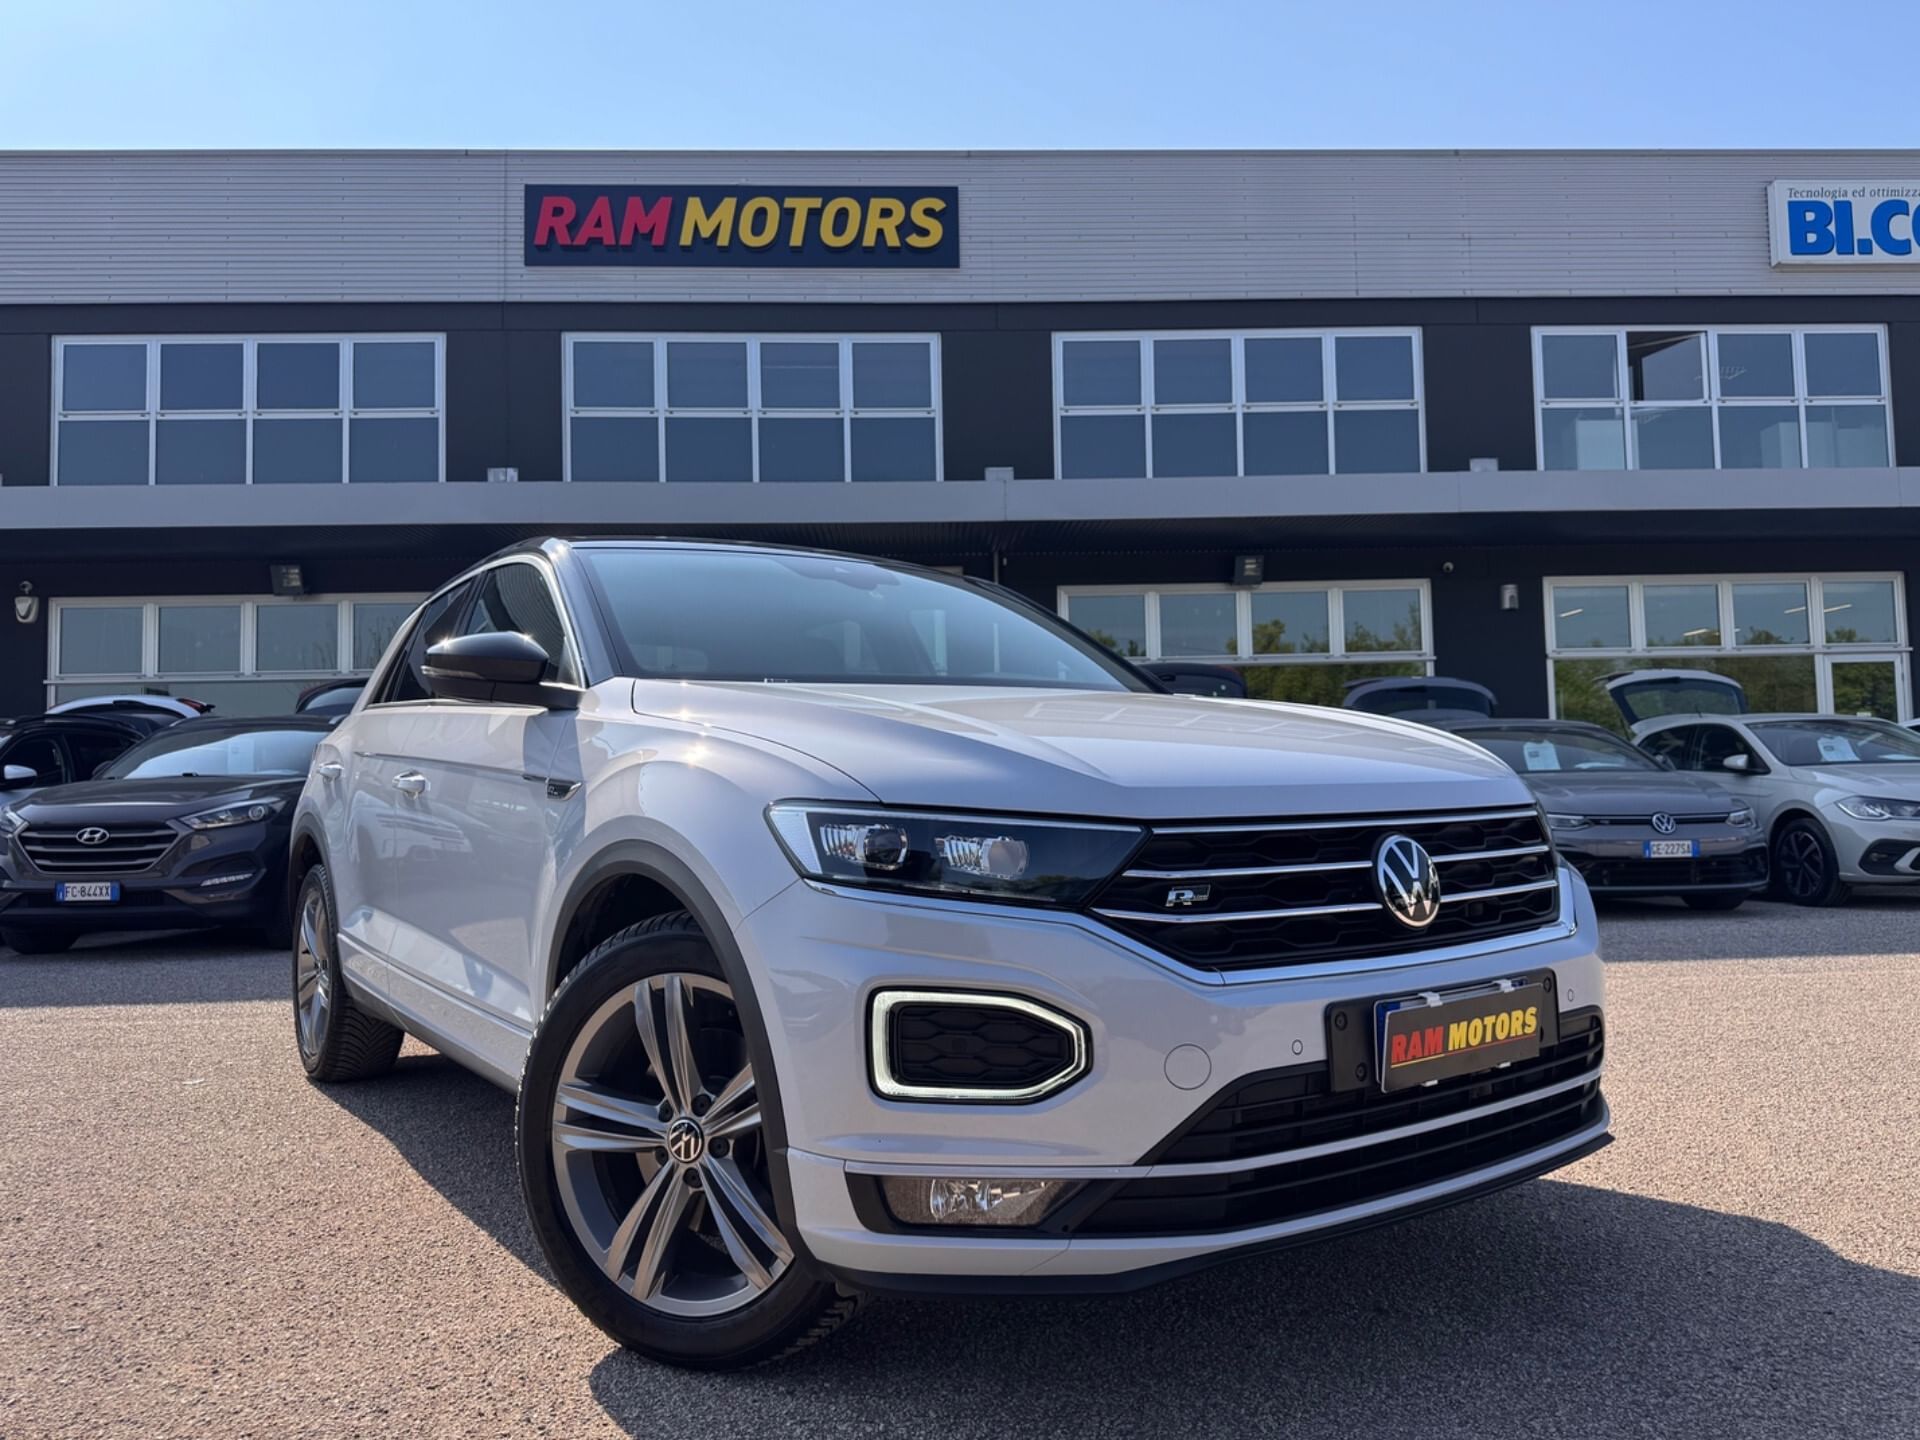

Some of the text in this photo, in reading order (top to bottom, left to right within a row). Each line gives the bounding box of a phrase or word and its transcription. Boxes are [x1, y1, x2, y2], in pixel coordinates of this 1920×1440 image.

[1788, 187, 1848, 199] Tecnologia
[1852, 187, 1865, 198] ed
[533, 196, 947, 249] RAM MOTORS
[1787, 199, 1920, 256] BI.C
[1391, 1006, 1537, 1064] RAM MOTORS
